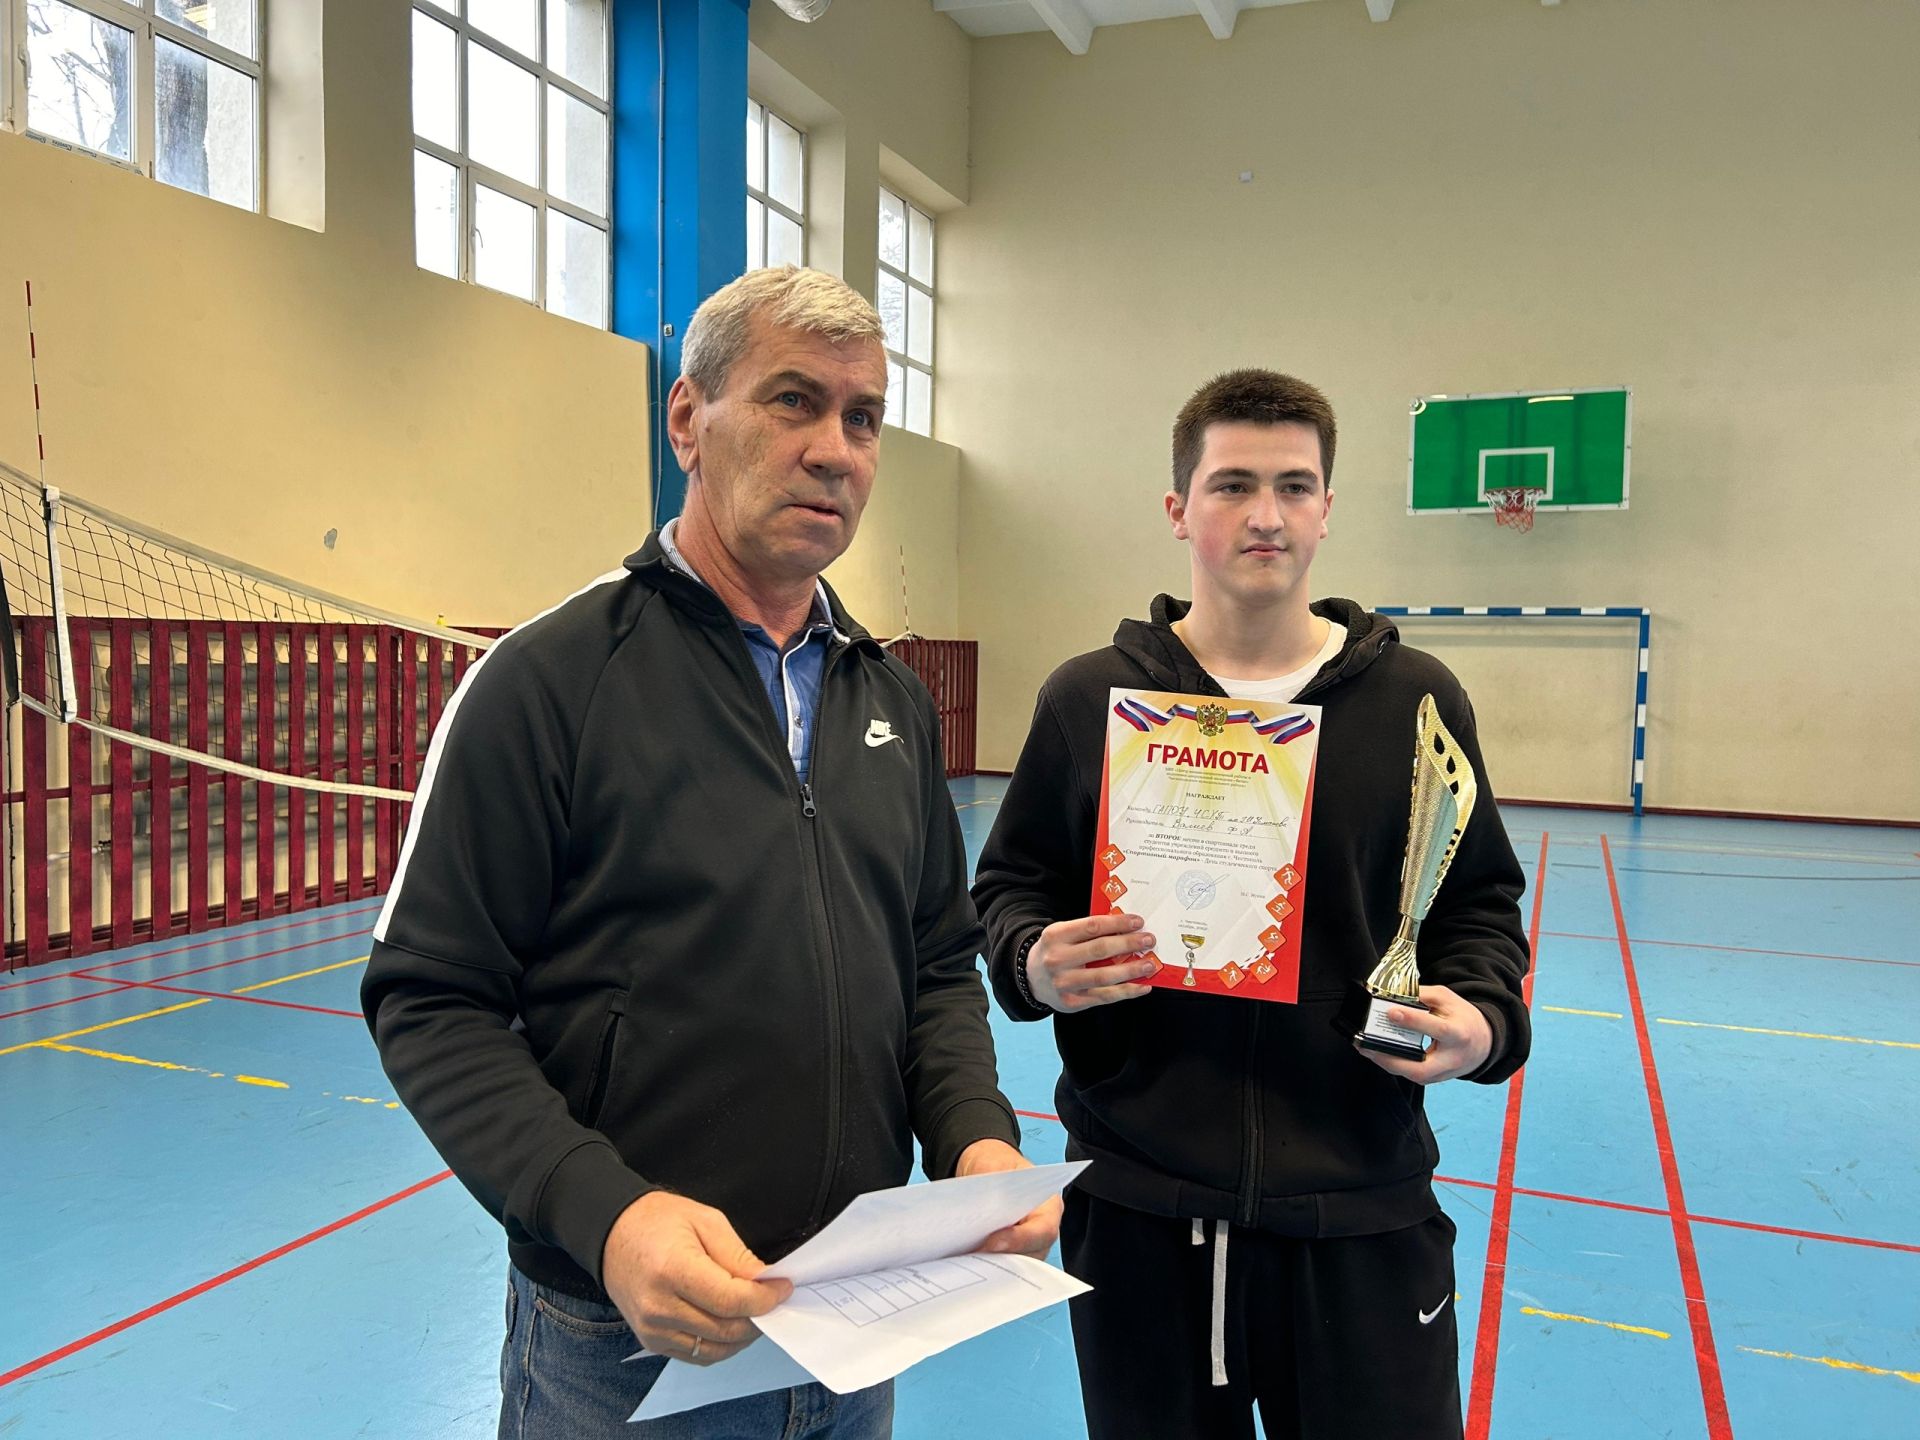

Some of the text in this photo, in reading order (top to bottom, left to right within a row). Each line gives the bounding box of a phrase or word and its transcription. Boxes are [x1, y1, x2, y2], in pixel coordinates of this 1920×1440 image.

[1147, 743, 1269, 774] ГРАМОТА
[1186, 792, 1225, 801] НАГРАЖДАЕТ
[1155, 833, 1181, 841] ВТОРОЕ
[1122, 849, 1168, 859] «Спортивный
[1168, 855, 1201, 863] марафон»
[1219, 860, 1258, 870] студенческого
